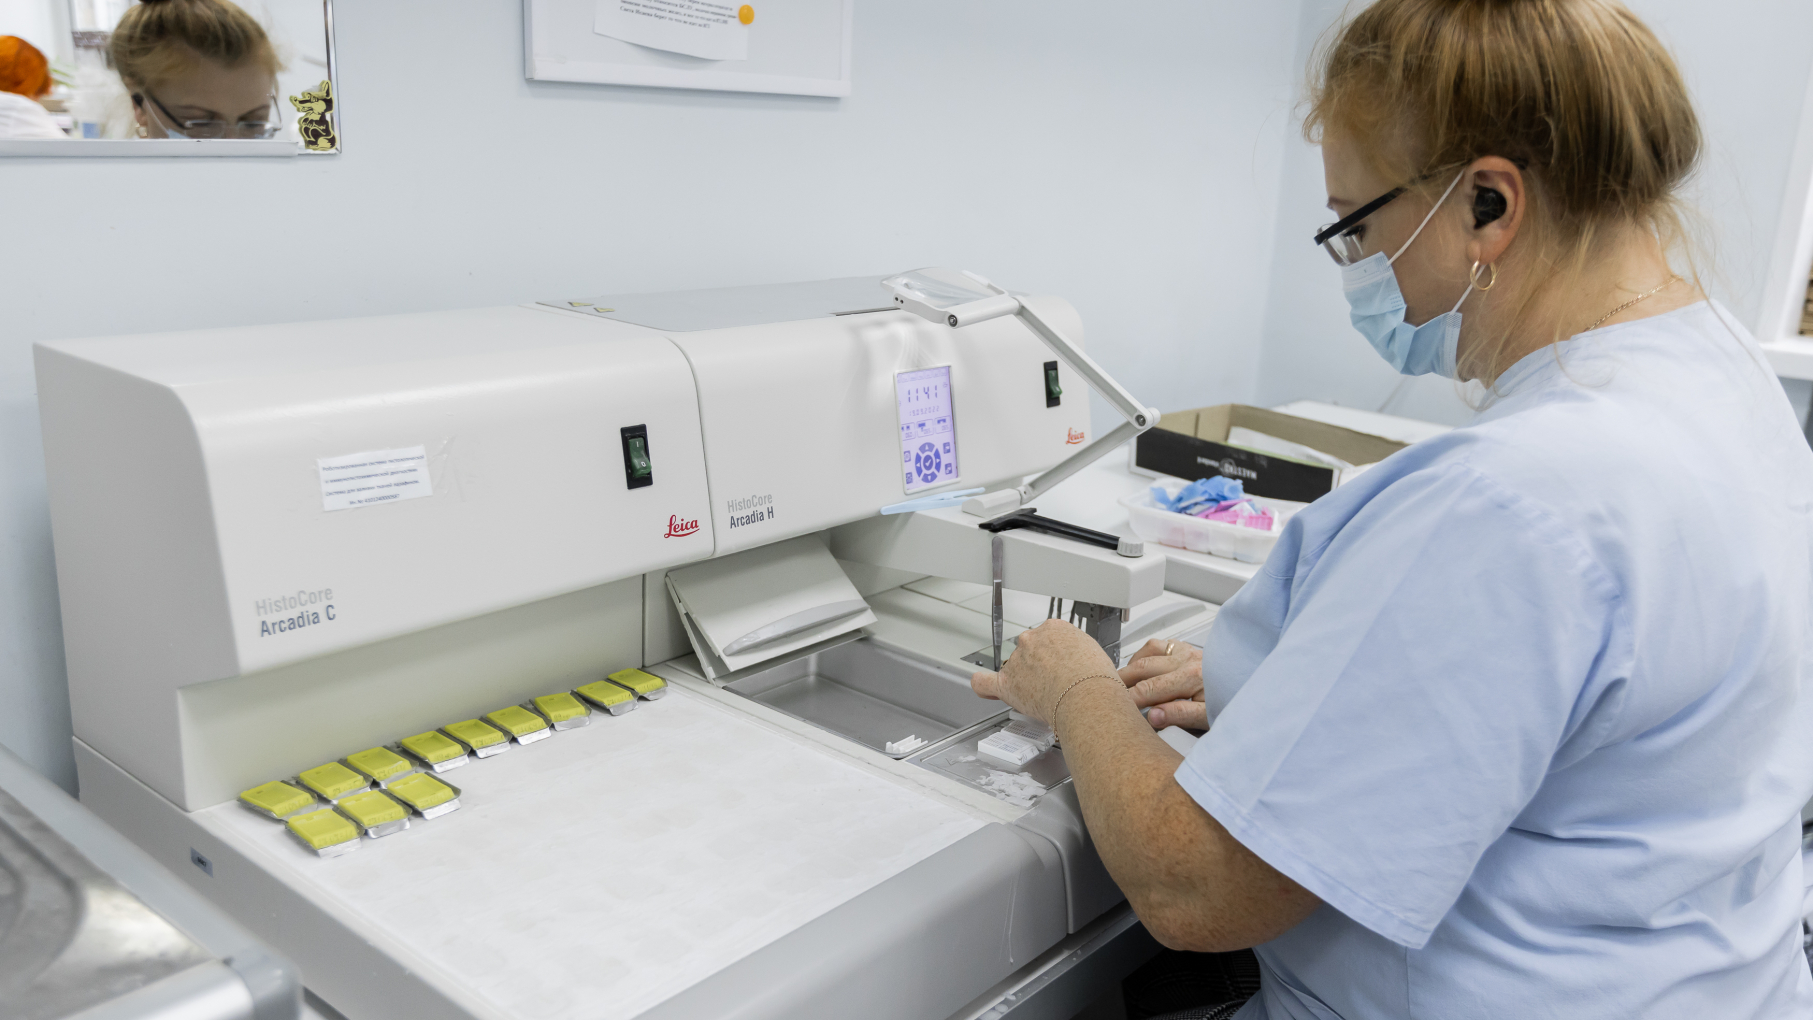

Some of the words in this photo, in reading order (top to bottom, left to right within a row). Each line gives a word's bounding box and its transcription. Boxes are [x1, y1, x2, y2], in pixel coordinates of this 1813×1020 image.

[1065, 427, 1085, 445] Leica
[727, 494, 773, 513] HistoCore
[663, 514, 700, 539] Leica
[730, 510, 764, 529] Arcadia
[767, 506, 774, 520] H
[255, 588, 333, 616] HistoCore
[260, 611, 321, 637] Arcadia
[325, 604, 336, 621] C
